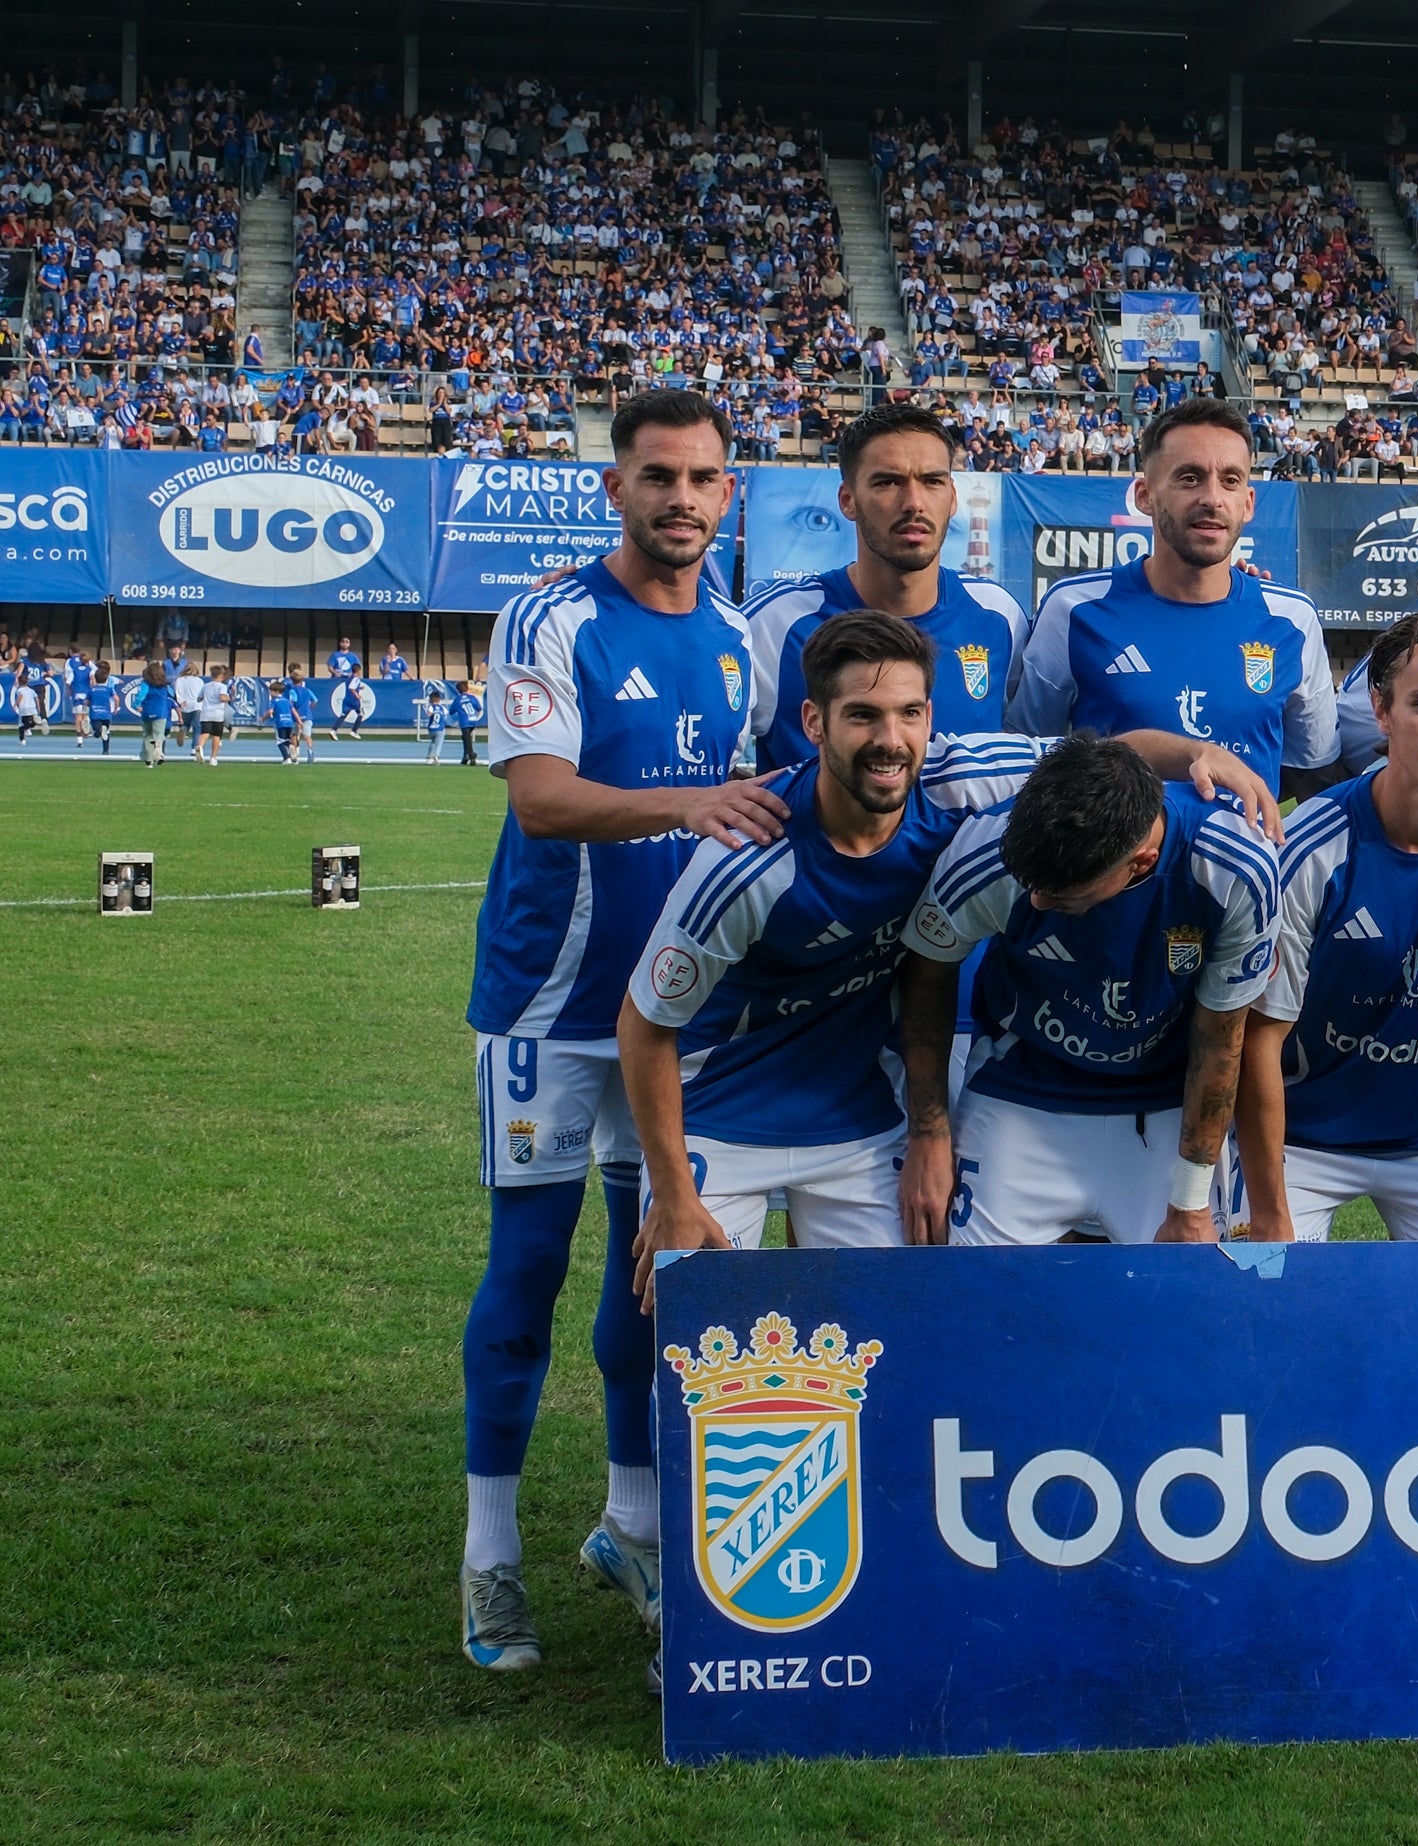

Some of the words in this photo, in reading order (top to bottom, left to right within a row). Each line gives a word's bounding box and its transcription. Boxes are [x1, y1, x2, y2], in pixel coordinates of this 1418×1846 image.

[148, 455, 301, 508] DISTRIBUCIONES
[306, 458, 395, 513] CÁRNICAS
[175, 507, 374, 555] LUGO
[469, 531, 501, 542] nada
[504, 531, 534, 543] sirve
[536, 535, 556, 545] ser
[558, 534, 570, 545] el
[572, 534, 610, 548] mejor,
[543, 554, 571, 568] 621
[122, 584, 148, 599] 608
[151, 584, 178, 599] 394
[181, 585, 205, 600] 823
[339, 588, 364, 603] 664
[366, 589, 392, 604] 793
[395, 590, 420, 604] 236
[1361, 578, 1408, 597] 633
[508, 1038, 538, 1103] 9
[721, 1428, 840, 1580] XEREZ
[688, 1657, 810, 1695] XEREZ
[820, 1654, 873, 1688] CD
